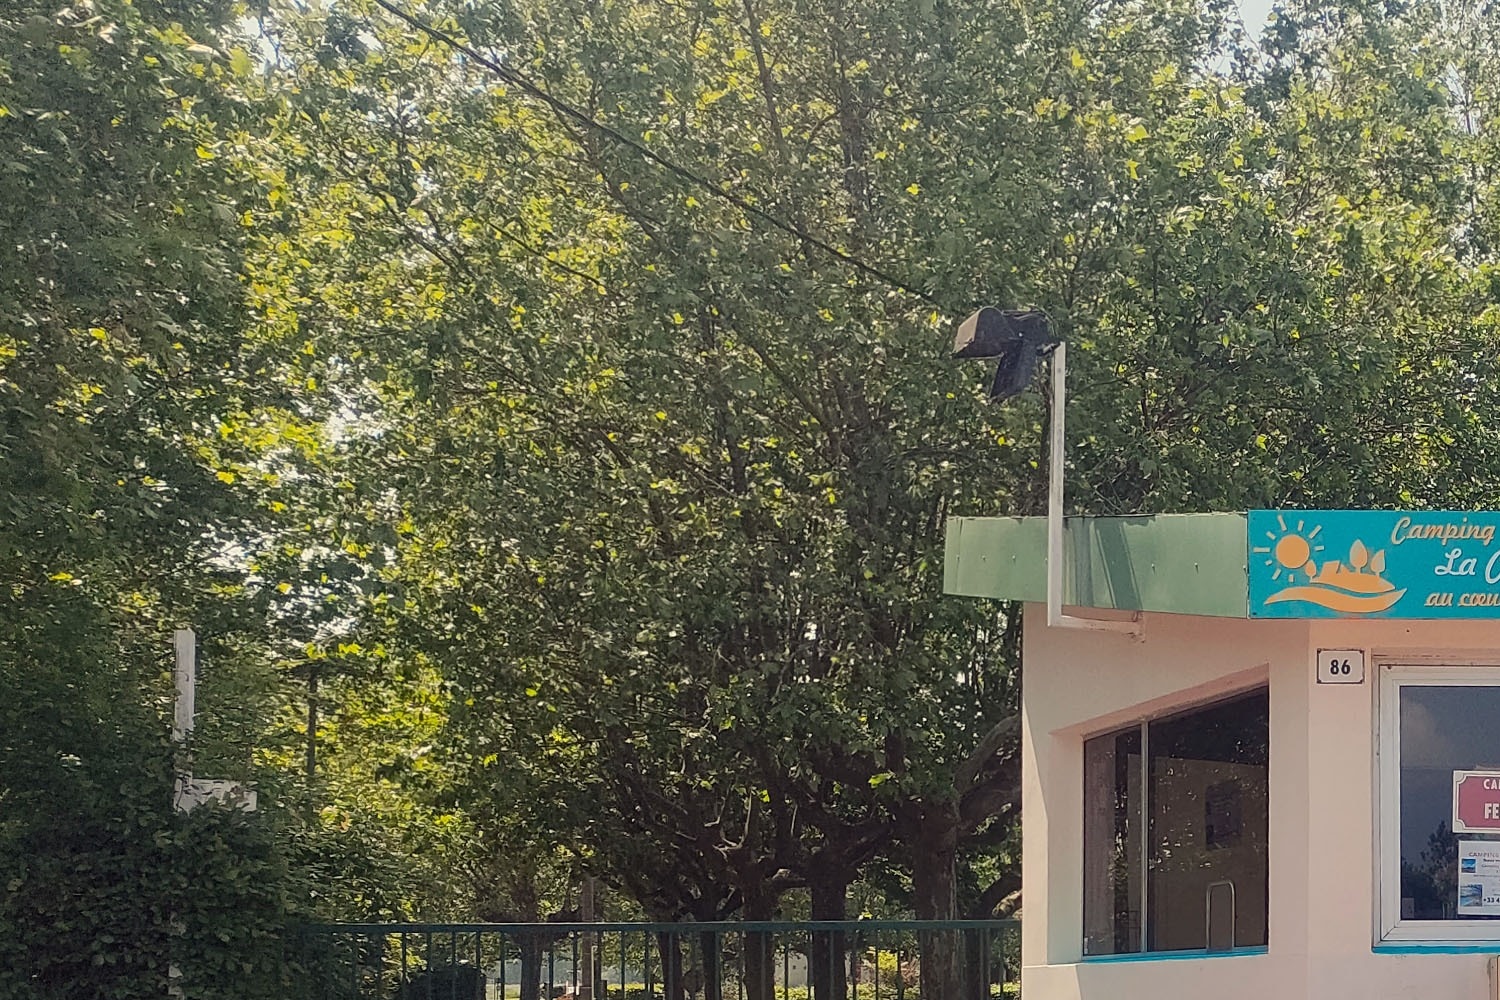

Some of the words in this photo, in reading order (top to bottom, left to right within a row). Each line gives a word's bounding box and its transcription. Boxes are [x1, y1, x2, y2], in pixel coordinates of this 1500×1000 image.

[1390, 516, 1496, 546] Camping
[1434, 547, 1477, 576] La
[1424, 592, 1454, 606] au
[1330, 659, 1351, 675] 86
